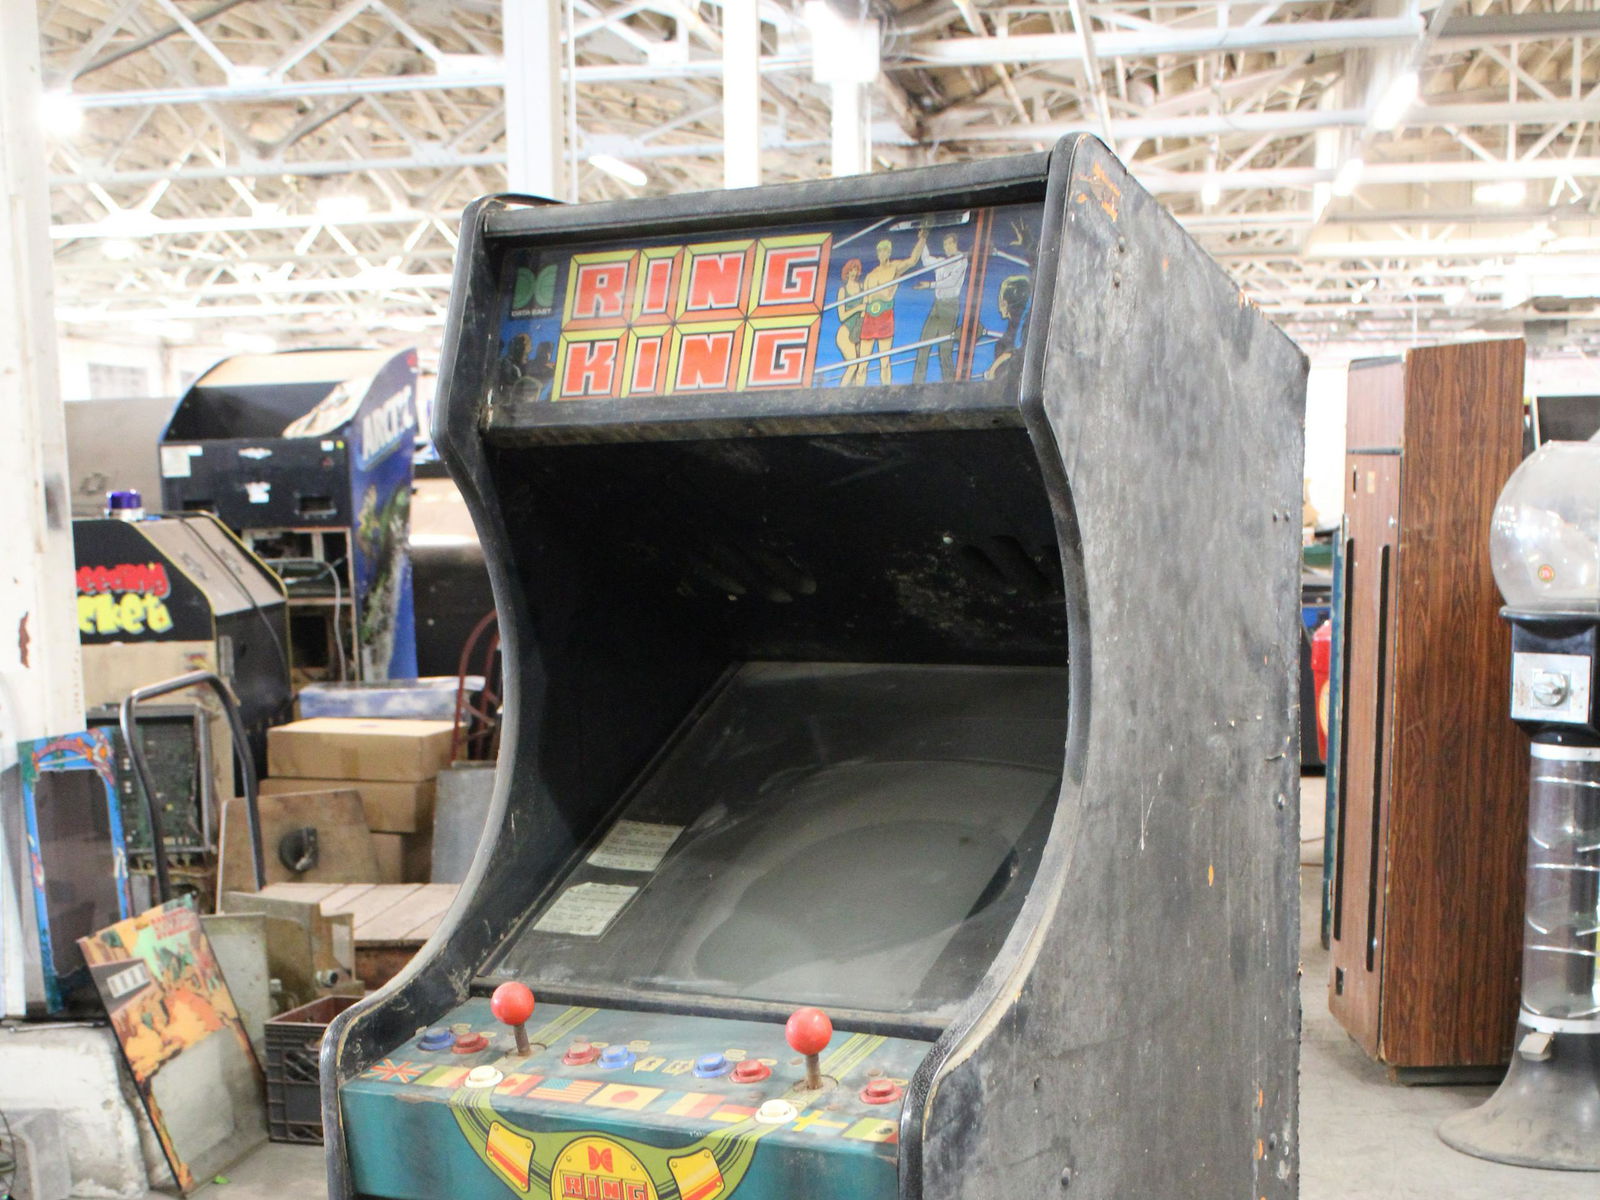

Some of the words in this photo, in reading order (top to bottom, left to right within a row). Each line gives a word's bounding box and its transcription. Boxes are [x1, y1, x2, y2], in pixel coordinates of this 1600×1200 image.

[531, 307, 552, 317] EAST
[572, 245, 822, 318] RING
[561, 326, 811, 398] KING
